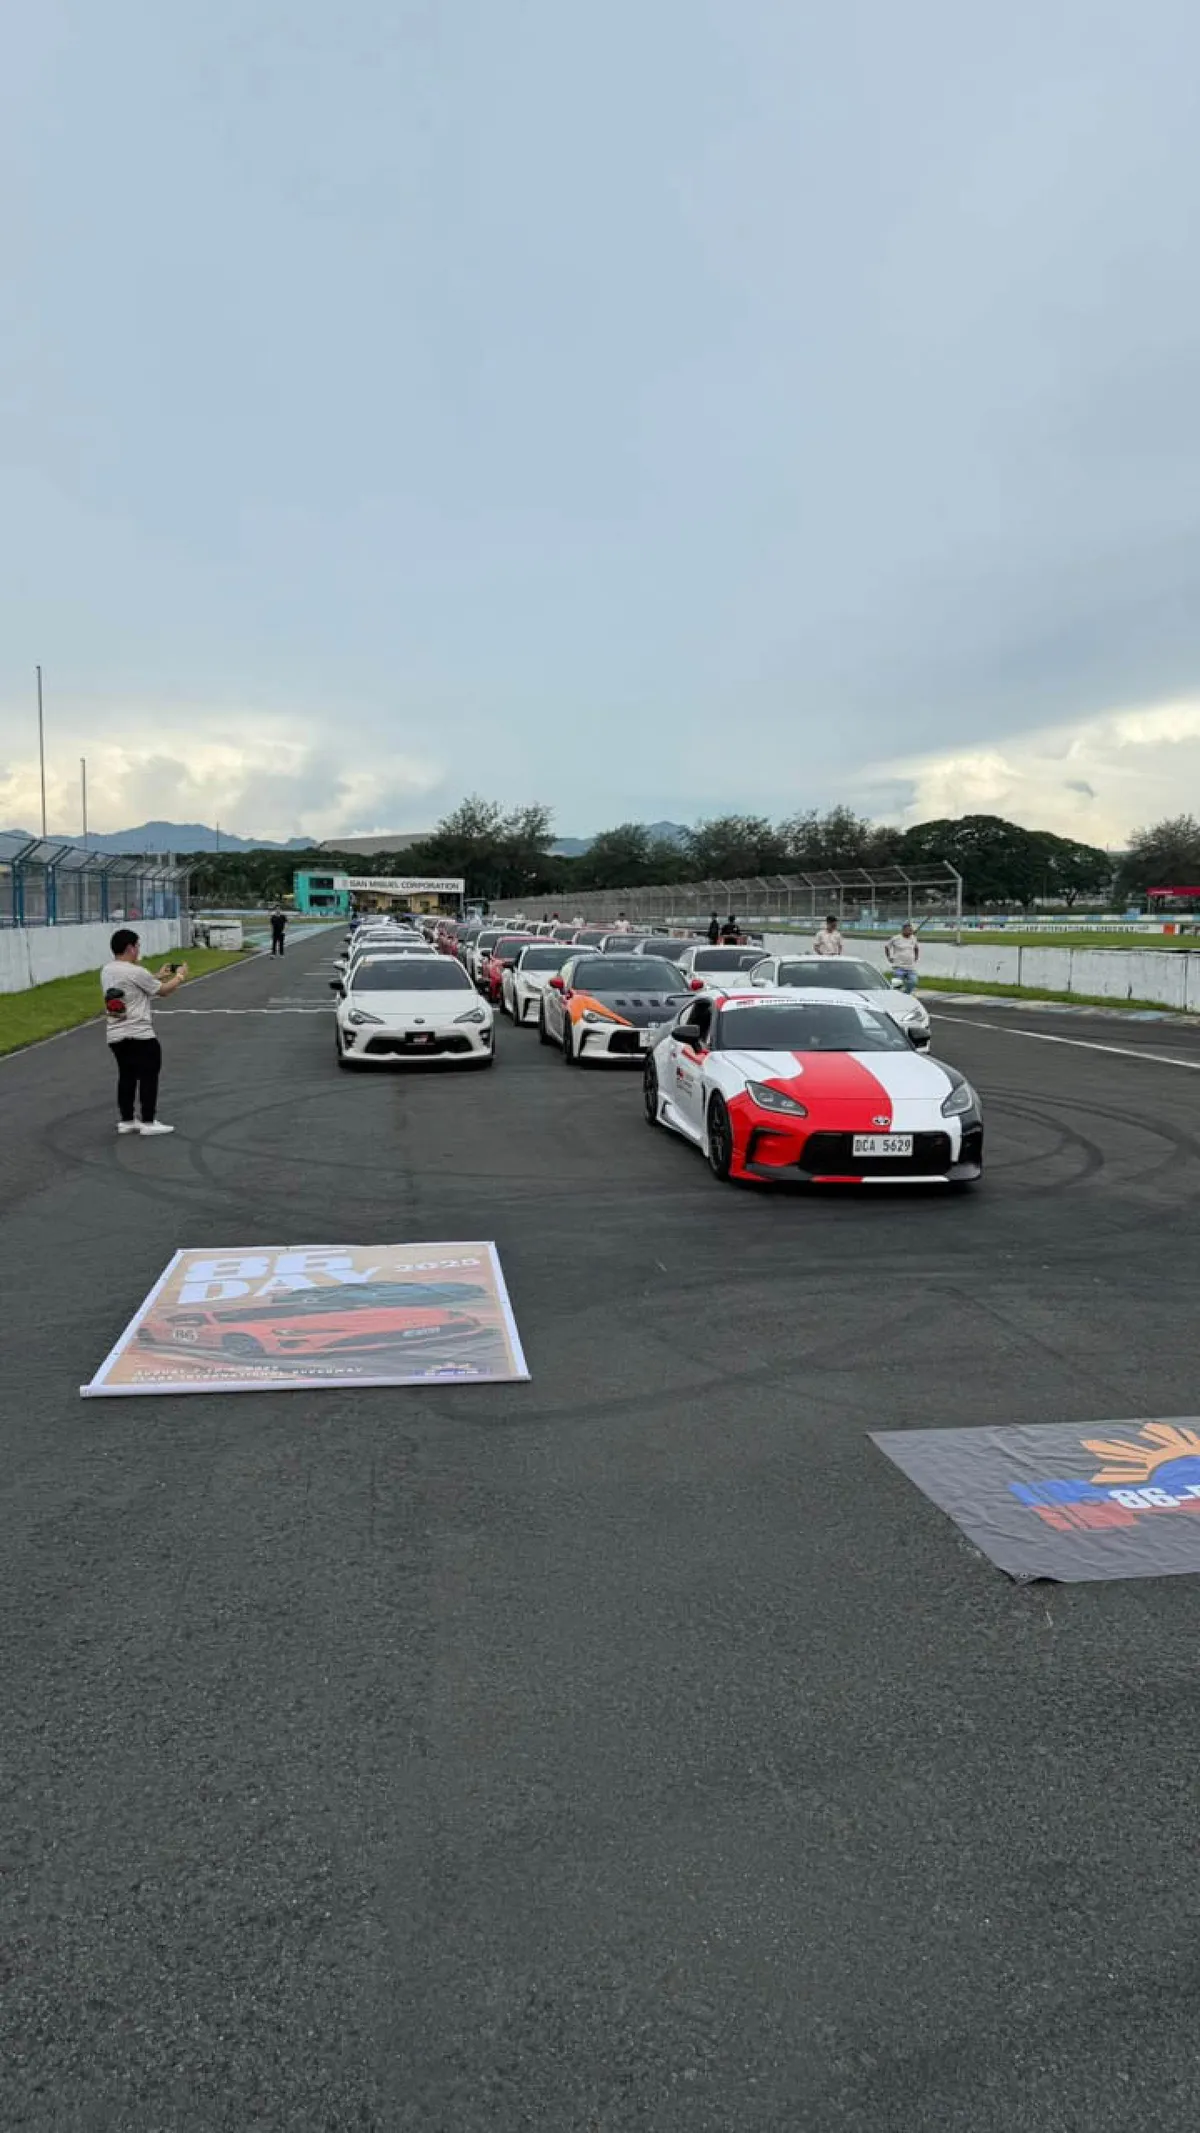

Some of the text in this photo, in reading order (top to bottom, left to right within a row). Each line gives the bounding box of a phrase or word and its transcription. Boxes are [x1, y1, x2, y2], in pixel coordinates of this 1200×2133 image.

[370, 880, 399, 888] MIGUEL
[401, 880, 459, 890] CORPORATION
[855, 1139, 911, 1152] DCA 5629
[185, 1250, 354, 1282] 86
[393, 1257, 481, 1273] 2025
[177, 1266, 382, 1304] DAY
